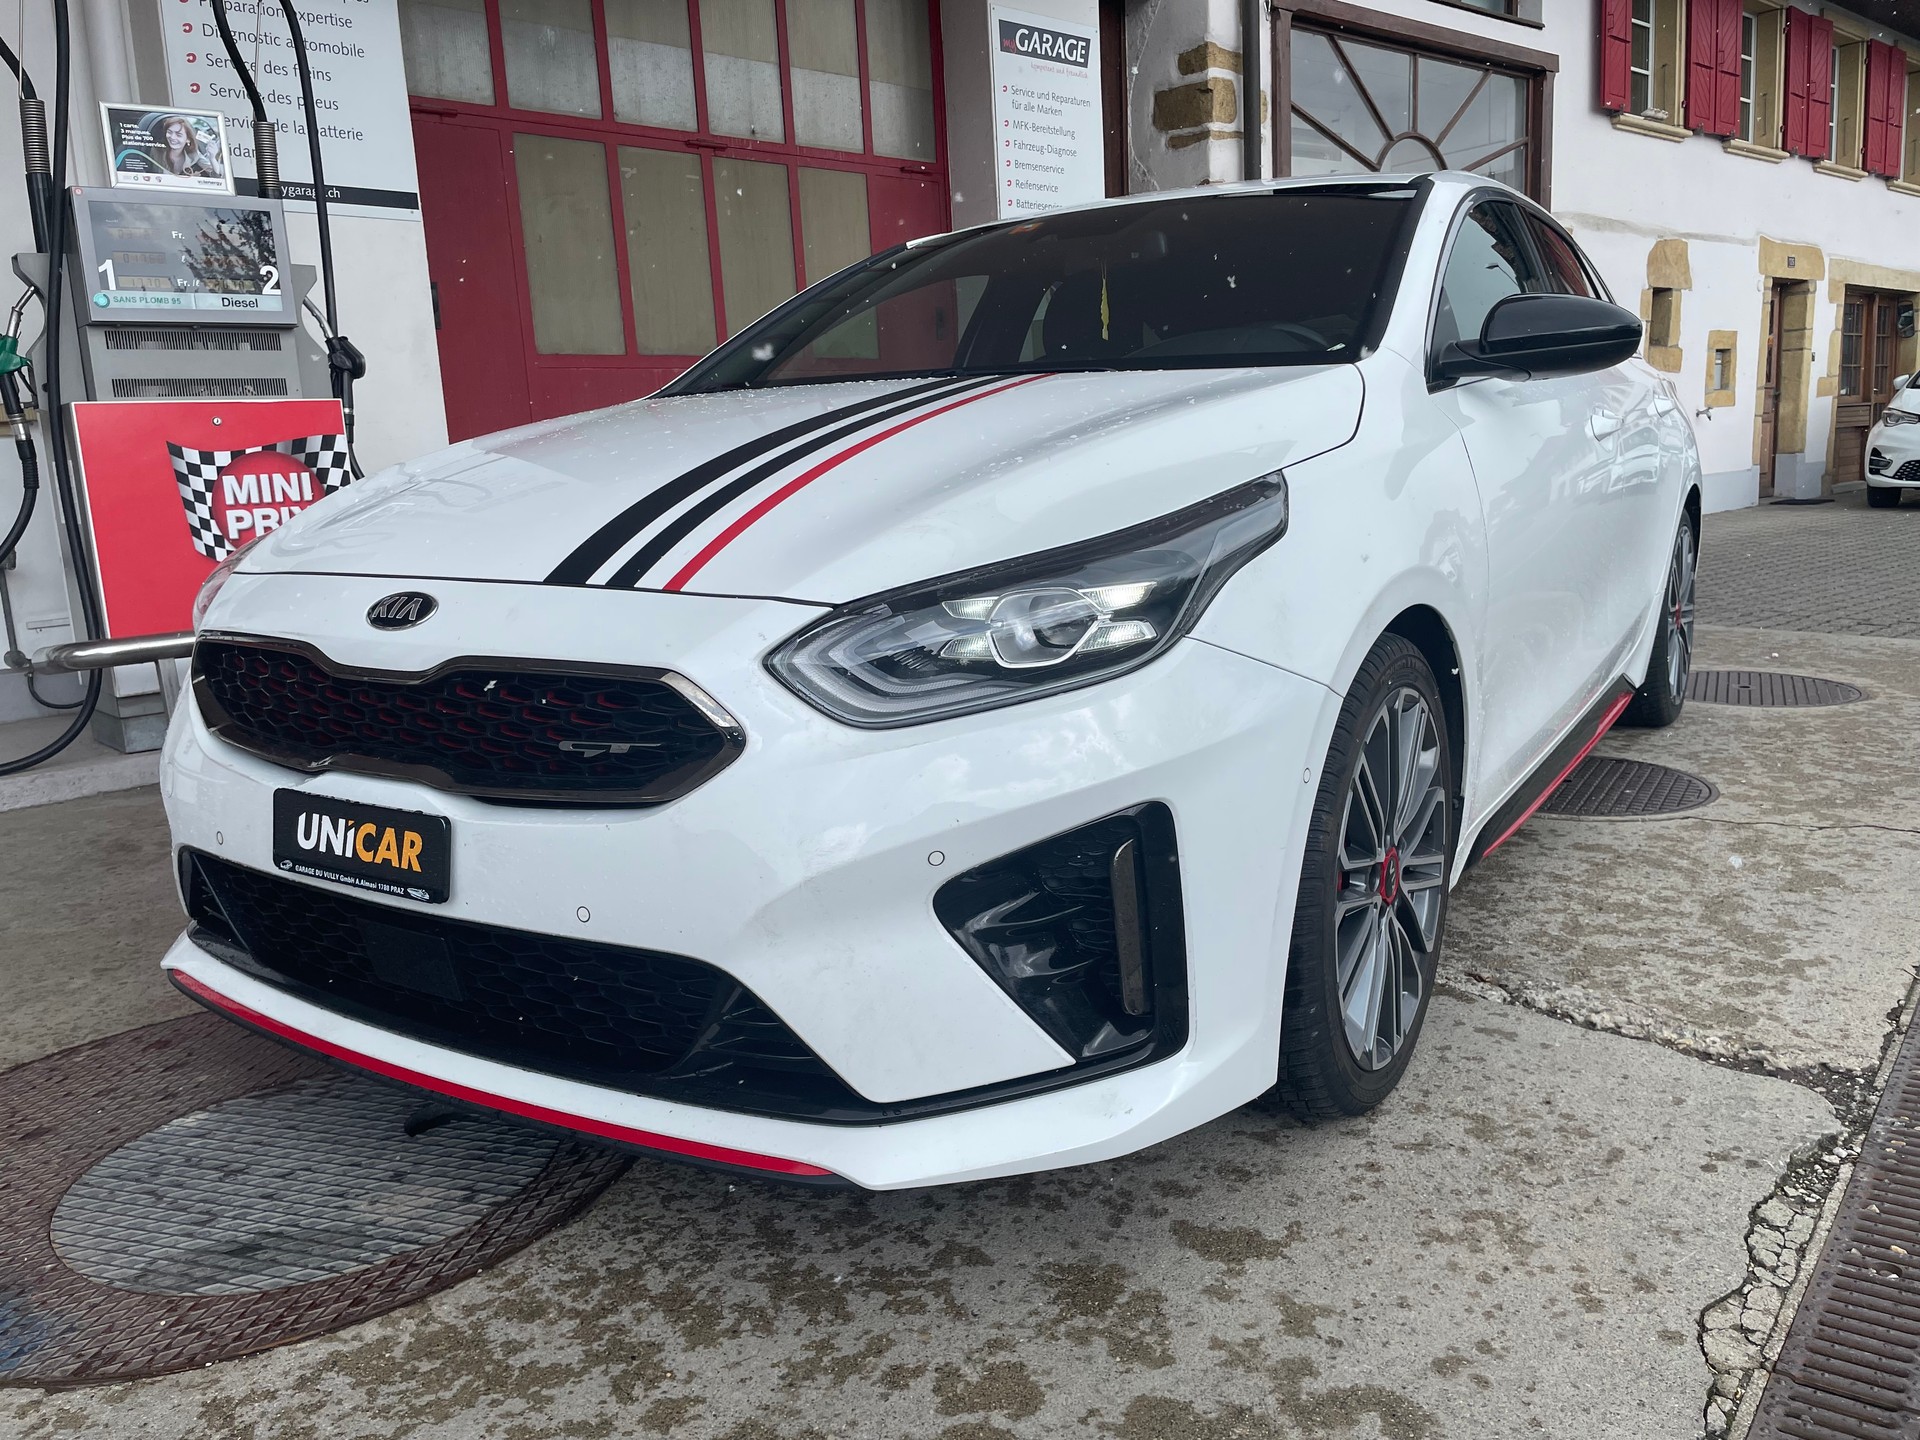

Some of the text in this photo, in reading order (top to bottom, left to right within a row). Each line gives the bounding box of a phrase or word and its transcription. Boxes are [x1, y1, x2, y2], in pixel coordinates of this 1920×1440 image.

[298, 11, 353, 29] xpertise
[202, 23, 365, 58] Dignostic atomobile
[264, 60, 289, 76] des
[293, 63, 332, 82] fins
[267, 89, 292, 105] des
[297, 96, 339, 111] peus
[1010, 85, 1091, 107] Service und Reparaturen
[1011, 99, 1063, 117] für alle Marken
[224, 116, 363, 141] ervic de la atterie
[1012, 119, 1076, 140] MFK-Bereitstellung
[1013, 140, 1078, 158] Fahrzeug-Diagnose
[1014, 159, 1065, 174] Bremsenservice
[281, 185, 341, 199] ygarag.ch
[1015, 179, 1059, 193] Reifenservice
[171, 231, 185, 240] Fr.
[98, 259, 116, 291] 1
[177, 278, 191, 287] Fr.
[259, 265, 282, 295] 2
[113, 295, 182, 305] SANS PLOMB 95
[221, 297, 259, 308] Diesel
[222, 471, 314, 506] MINI
[226, 505, 311, 540] PRI
[371, 596, 424, 621] KIA
[294, 864, 315, 876] GARAGE
[315, 869, 323, 877] DU
[323, 871, 339, 881] VULLY
[339, 874, 355, 884] GmbH
[390, 885, 405, 895] PRAZ
